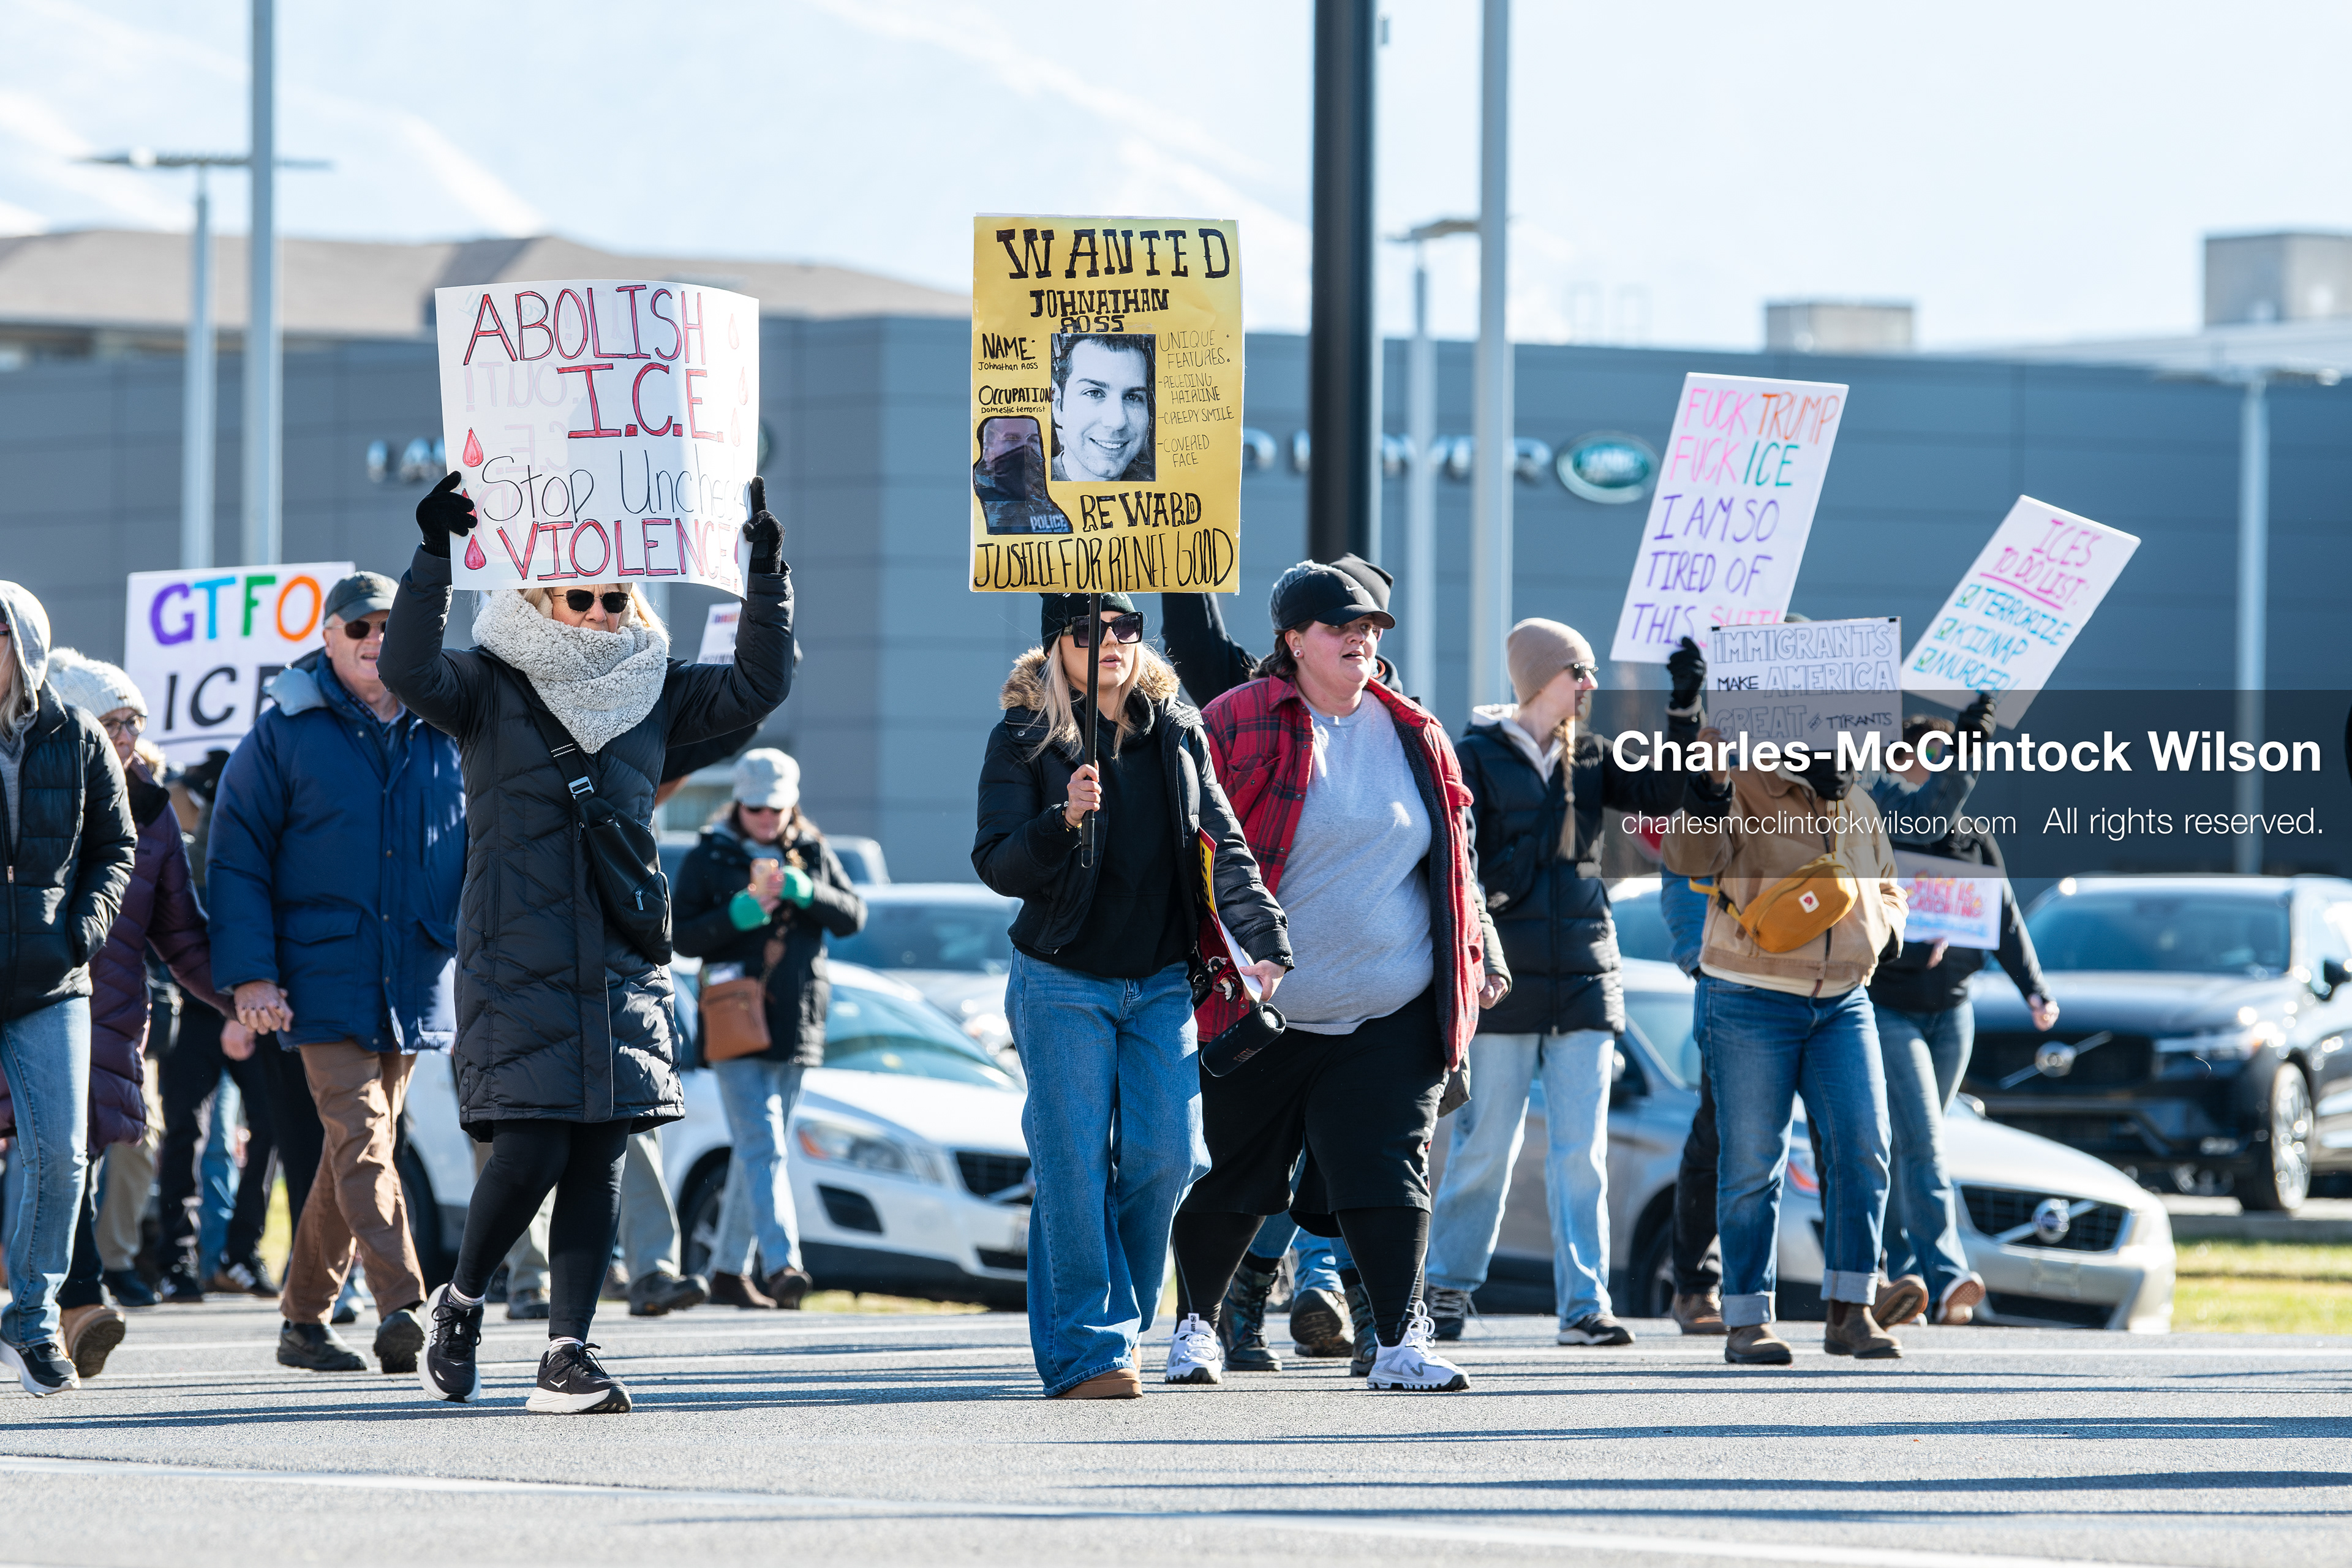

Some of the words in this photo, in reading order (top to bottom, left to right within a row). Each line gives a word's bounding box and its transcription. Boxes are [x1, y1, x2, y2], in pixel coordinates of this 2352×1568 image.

[996, 228, 1231, 279] WANTED
[463, 284, 706, 365] ABOLISH
[1029, 288, 1169, 317] JOHNATHAN
[1159, 330, 1216, 352] UNIQUE
[556, 363, 725, 443] I.C.E.
[1170, 386, 1221, 404] HAIRLINE
[1201, 406, 1235, 422] SMILE
[1683, 386, 1755, 437] FUCK
[1757, 390, 1841, 445] TRUMP
[1172, 452, 1199, 468] FACE
[1669, 435, 1741, 486] FUCK
[1743, 440, 1801, 487] ICE
[482, 456, 594, 522] Stop
[1030, 514, 1066, 532] POLICE
[1079, 491, 1202, 532] REWARD
[1653, 494, 1683, 541] I
[1683, 496, 1735, 543] AM
[1733, 499, 1781, 543] SO
[973, 540, 1060, 589] JUSTICE
[1058, 537, 1103, 590] FOR
[1109, 532, 1170, 592] RENEE
[1177, 527, 1234, 587] GOOD
[1646, 550, 1716, 594] TIRED
[1725, 554, 1774, 598] OF
[2014, 554, 2045, 584] DO
[149, 574, 323, 647] GTFO
[1632, 603, 1698, 647] THIS
[1975, 588, 2073, 647] TERRORIZE
[1714, 624, 1893, 664] IMMIGRANTS
[1949, 620, 2029, 666] KIDNAP
[1717, 675, 1760, 692] MAKE
[1763, 660, 1898, 698] AMERICA
[1714, 704, 1807, 741] GREAT
[1825, 712, 1893, 729] TYRANTS
